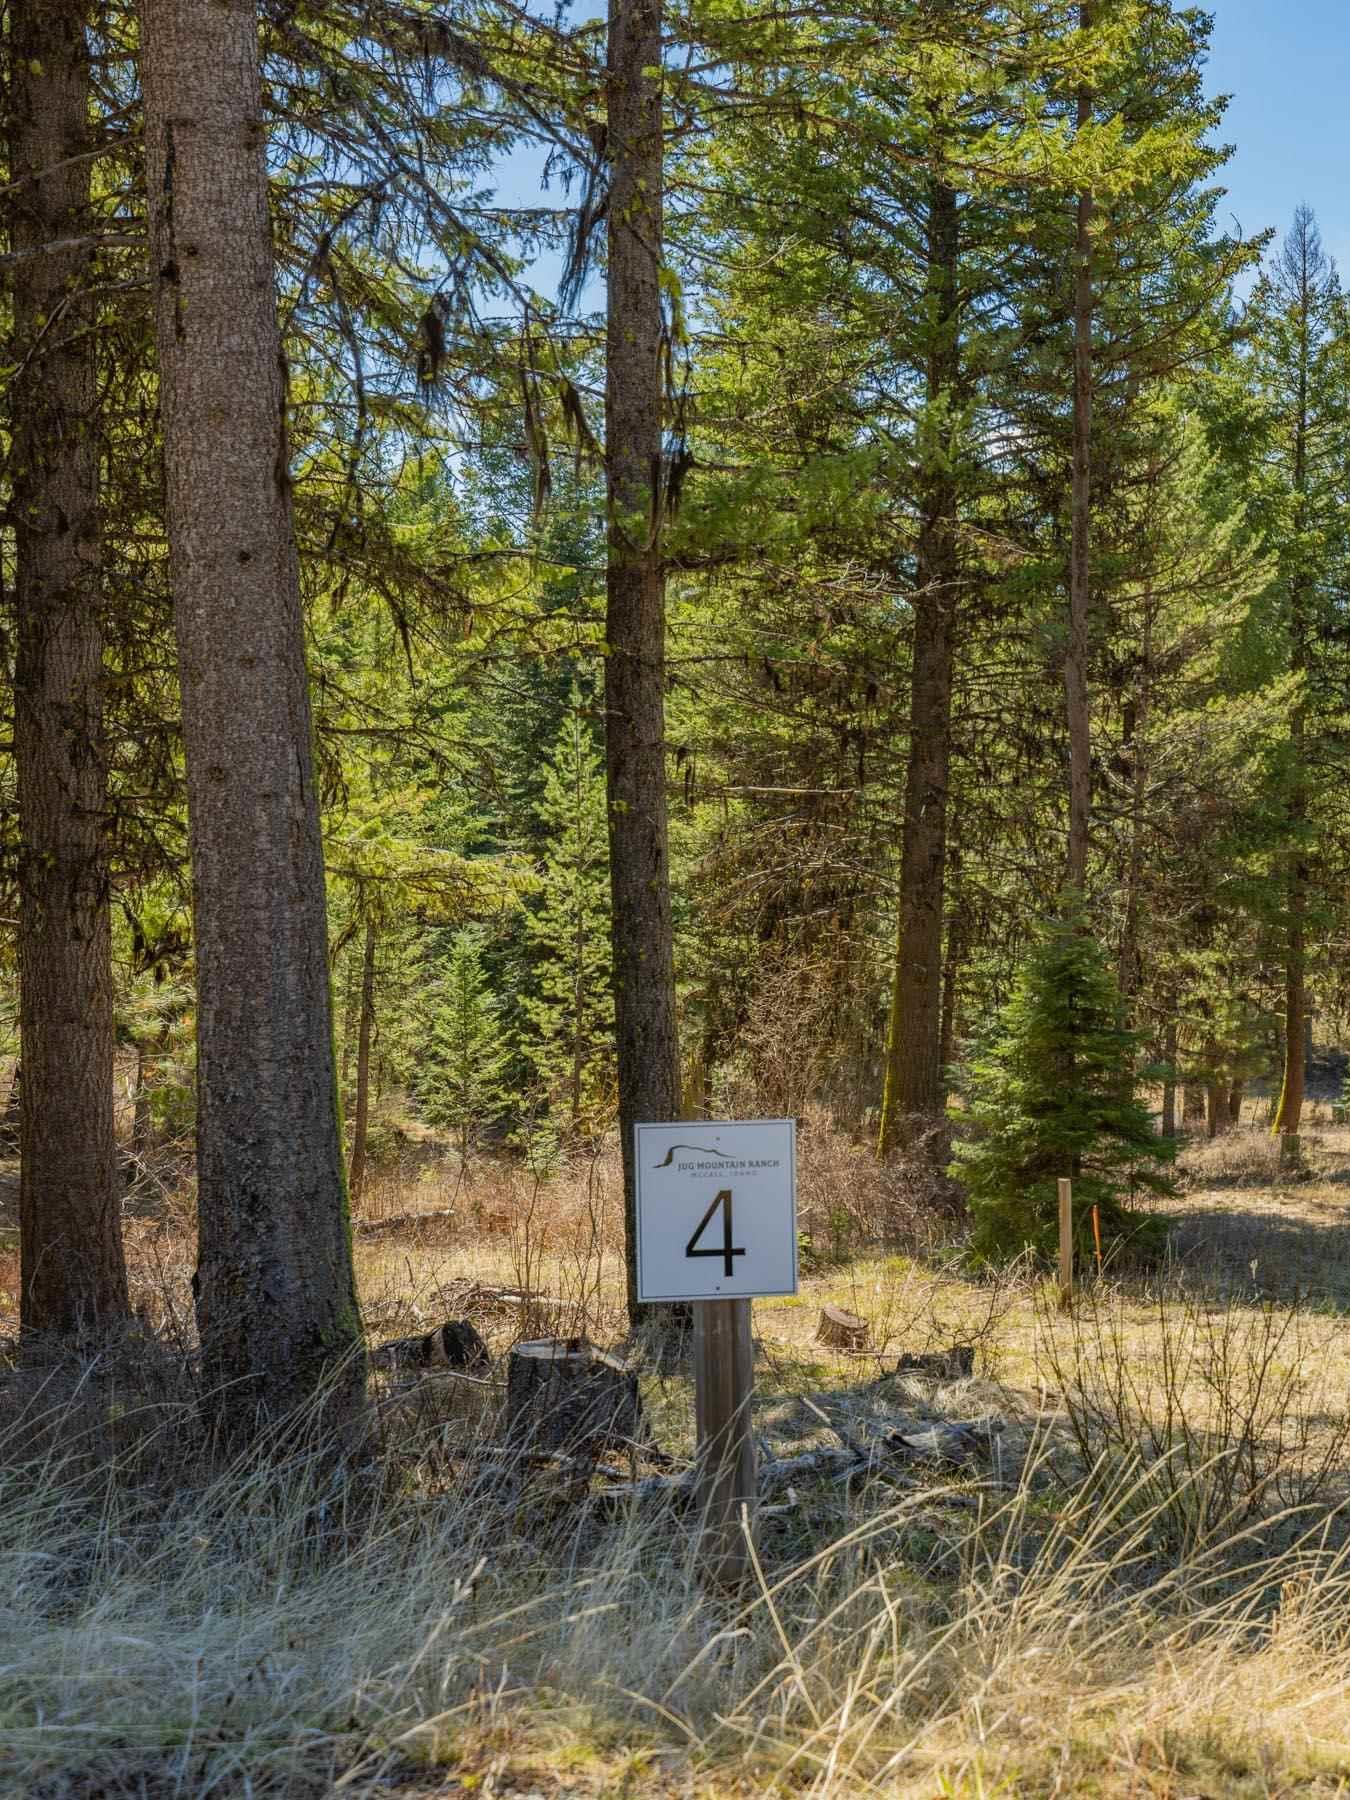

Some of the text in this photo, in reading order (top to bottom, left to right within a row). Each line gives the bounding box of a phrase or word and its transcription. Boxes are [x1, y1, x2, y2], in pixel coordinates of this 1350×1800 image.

[678, 1159, 780, 1171] JUG MOUNTAIN RANCH
[685, 1189, 746, 1277] 4
